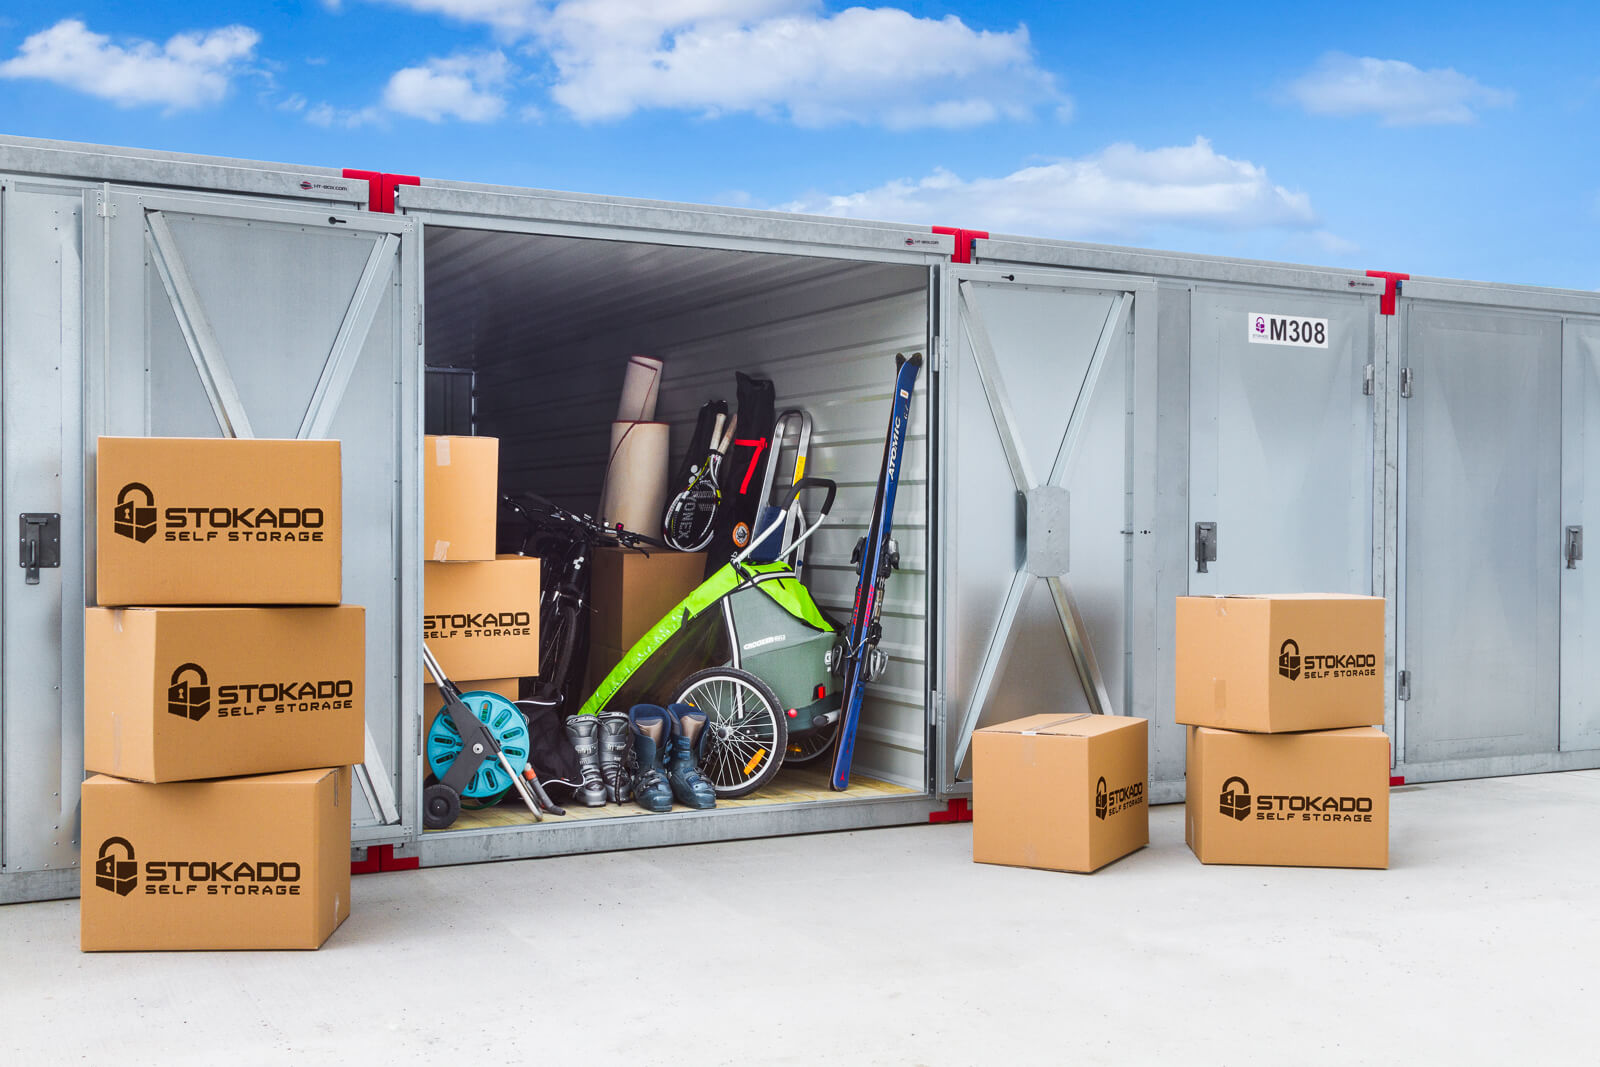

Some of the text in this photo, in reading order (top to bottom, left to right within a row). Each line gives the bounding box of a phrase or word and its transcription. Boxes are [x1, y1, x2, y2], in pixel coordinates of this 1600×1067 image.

[1270, 318, 1325, 344] M308
[888, 416, 901, 480] ATOMIC
[166, 508, 324, 529] STOKADO
[165, 531, 324, 542] SELF STORAGE
[424, 612, 530, 629] STOKADO
[424, 628, 531, 639] SELF STORAGE
[1304, 654, 1376, 670] STOKADO
[1304, 669, 1376, 679] SELF STORAGE
[218, 680, 353, 705] STOKADO
[218, 700, 353, 718] SELF STORAGE
[1108, 782, 1143, 807] STOKADO
[1257, 796, 1373, 812] STOKADO
[1257, 813, 1373, 823] SELF STORAGE
[145, 861, 301, 882] STOKADO
[145, 884, 301, 896] SELF STORAGE
